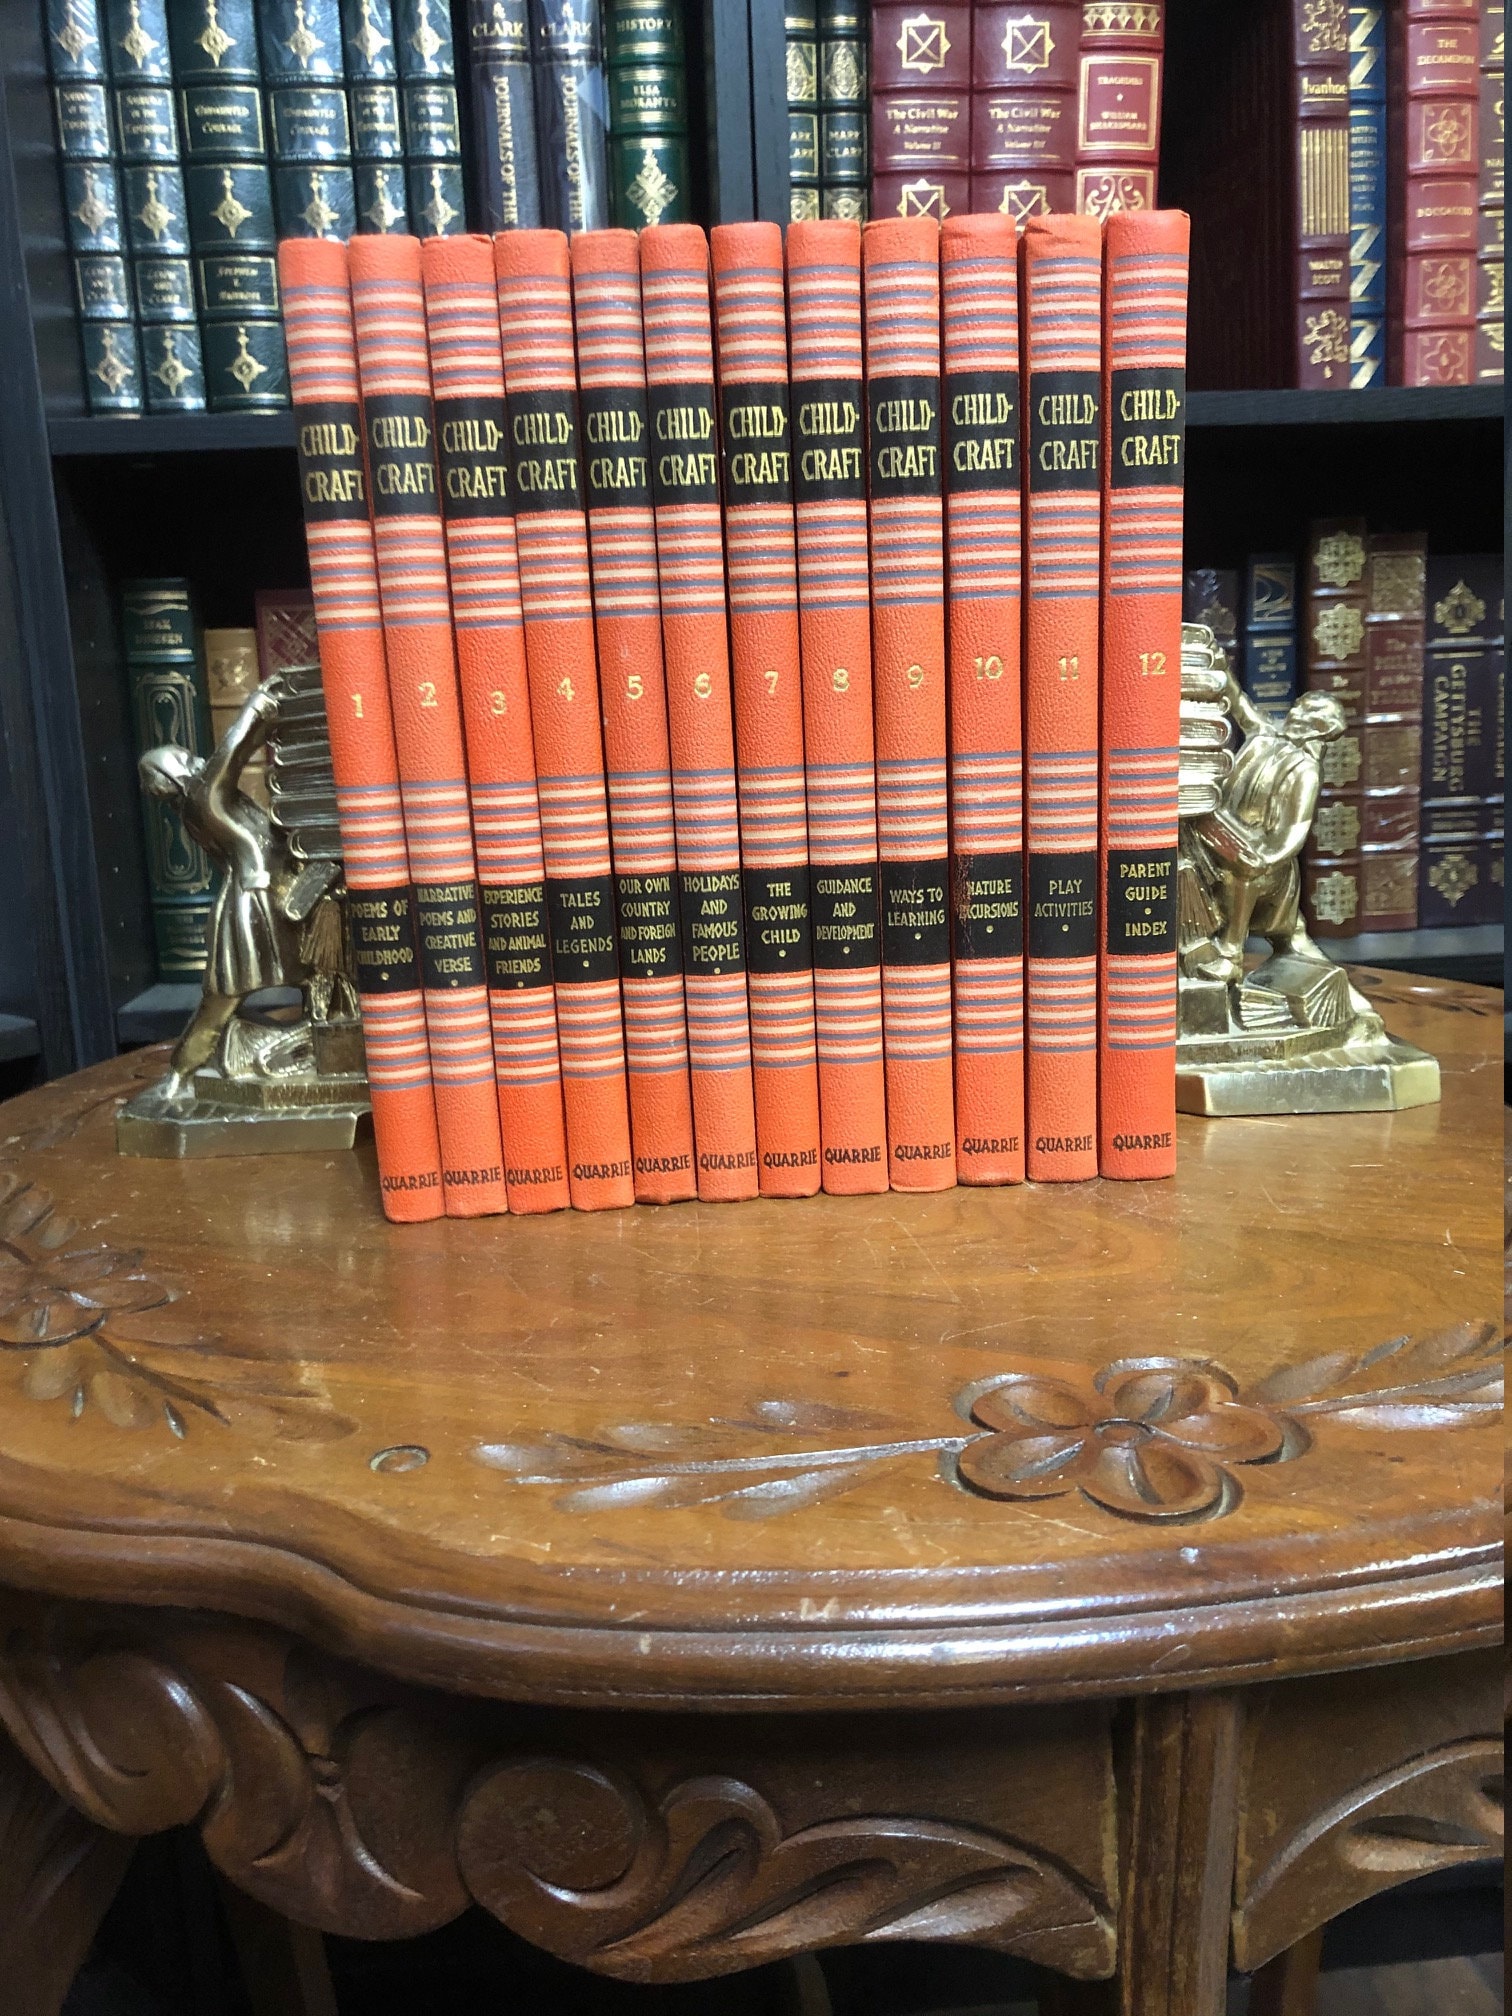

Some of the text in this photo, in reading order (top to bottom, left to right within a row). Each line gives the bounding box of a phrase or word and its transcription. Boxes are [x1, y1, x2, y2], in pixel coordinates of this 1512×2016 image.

[472, 21, 524, 38] CLARK
[540, 20, 592, 38] CLARK
[616, 17, 672, 32] HISTORY
[1438, 39, 1458, 48] THE
[1302, 77, 1347, 94] Ivanhoe
[493, 76, 514, 162] JOURNALS
[561, 74, 580, 162] JOURNALS
[887, 108, 959, 120] The Civil War
[988, 108, 1061, 119] The Civil War
[501, 163, 515, 186] OF
[953, 437, 1015, 472] CRAFT
[1039, 440, 1099, 471] CRAFT
[1121, 435, 1181, 466] CRAFT
[660, 453, 716, 486] CRAFT
[731, 452, 791, 485] CRAFT
[801, 447, 862, 481] CRAFT
[877, 445, 937, 478] CRAFT
[377, 462, 435, 495] CRAFT
[447, 466, 507, 498] CRAFT
[517, 458, 577, 492] CRAFT
[590, 456, 647, 489] CRAFT
[305, 469, 364, 502] CRAFT
[973, 655, 1004, 680] 10
[1058, 655, 1080, 681] 11
[1138, 651, 1167, 676] 12
[694, 672, 713, 698] 6
[764, 670, 779, 694] 7
[832, 668, 850, 692] 8
[907, 664, 924, 689] 9
[418, 682, 438, 707] 2
[557, 677, 575, 702] 4
[626, 675, 643, 700] 5
[351, 693, 363, 717] 1
[490, 690, 507, 715] 3
[1432, 676, 1449, 782] CAMPAIGN
[1449, 664, 1467, 792] GETTYSBURG
[1120, 861, 1171, 878] PARENT
[417, 883, 474, 903] NARRATIVE
[619, 876, 670, 895] OUR OWN
[683, 874, 740, 893] HOLIDAYS
[766, 882, 792, 898] THE
[816, 877, 872, 895] GUIDANCE
[966, 879, 1012, 896] NATURE
[1049, 879, 1083, 895] PLAY
[1125, 884, 1167, 901] GUIDE
[484, 886, 544, 905] EXPERIENCE
[560, 891, 601, 909] TALES
[889, 886, 943, 904] WAYS TO
[350, 899, 408, 918] POEMS OF
[420, 908, 477, 927] POEMS AND
[620, 900, 671, 918] COUNTRY
[701, 899, 728, 916] AND
[752, 903, 808, 921] GROWING
[832, 902, 856, 917] AND
[1034, 900, 1094, 917] ACTIVITIES
[490, 910, 540, 929] STORIES
[571, 915, 595, 931] AND
[888, 909, 945, 928] LEARNING
[1125, 920, 1167, 937] INDEX
[362, 925, 400, 942] EARLY
[620, 922, 676, 941] AND FOREIGN
[691, 920, 738, 940] FAMOUS
[761, 928, 801, 945] CHILD
[816, 922, 875, 941] DEVELOPMENT
[425, 932, 477, 950] CREATIVE
[488, 933, 547, 951] AND ANIMAL
[556, 935, 613, 954] LEGENDS
[631, 947, 666, 964] LANDS
[692, 942, 740, 962] PEOPLE
[434, 956, 473, 974] VERSE
[496, 957, 541, 975] FRIENDS
[962, 1136, 1019, 1155] QUARRIE
[1036, 1134, 1093, 1154] QUARRIE
[1112, 1132, 1172, 1151] QUARRIE
[700, 1150, 756, 1172] QUARRIE
[763, 1148, 818, 1169] QUARRIE
[824, 1145, 882, 1166] QUARRIE
[894, 1142, 952, 1162] QUARRIE
[572, 1160, 631, 1181] QUARRIE
[636, 1153, 691, 1175] QUARRIE
[382, 1171, 440, 1192] QUARRIE
[443, 1165, 501, 1187] QUARRIE
[506, 1165, 563, 1185] QUARRIE
